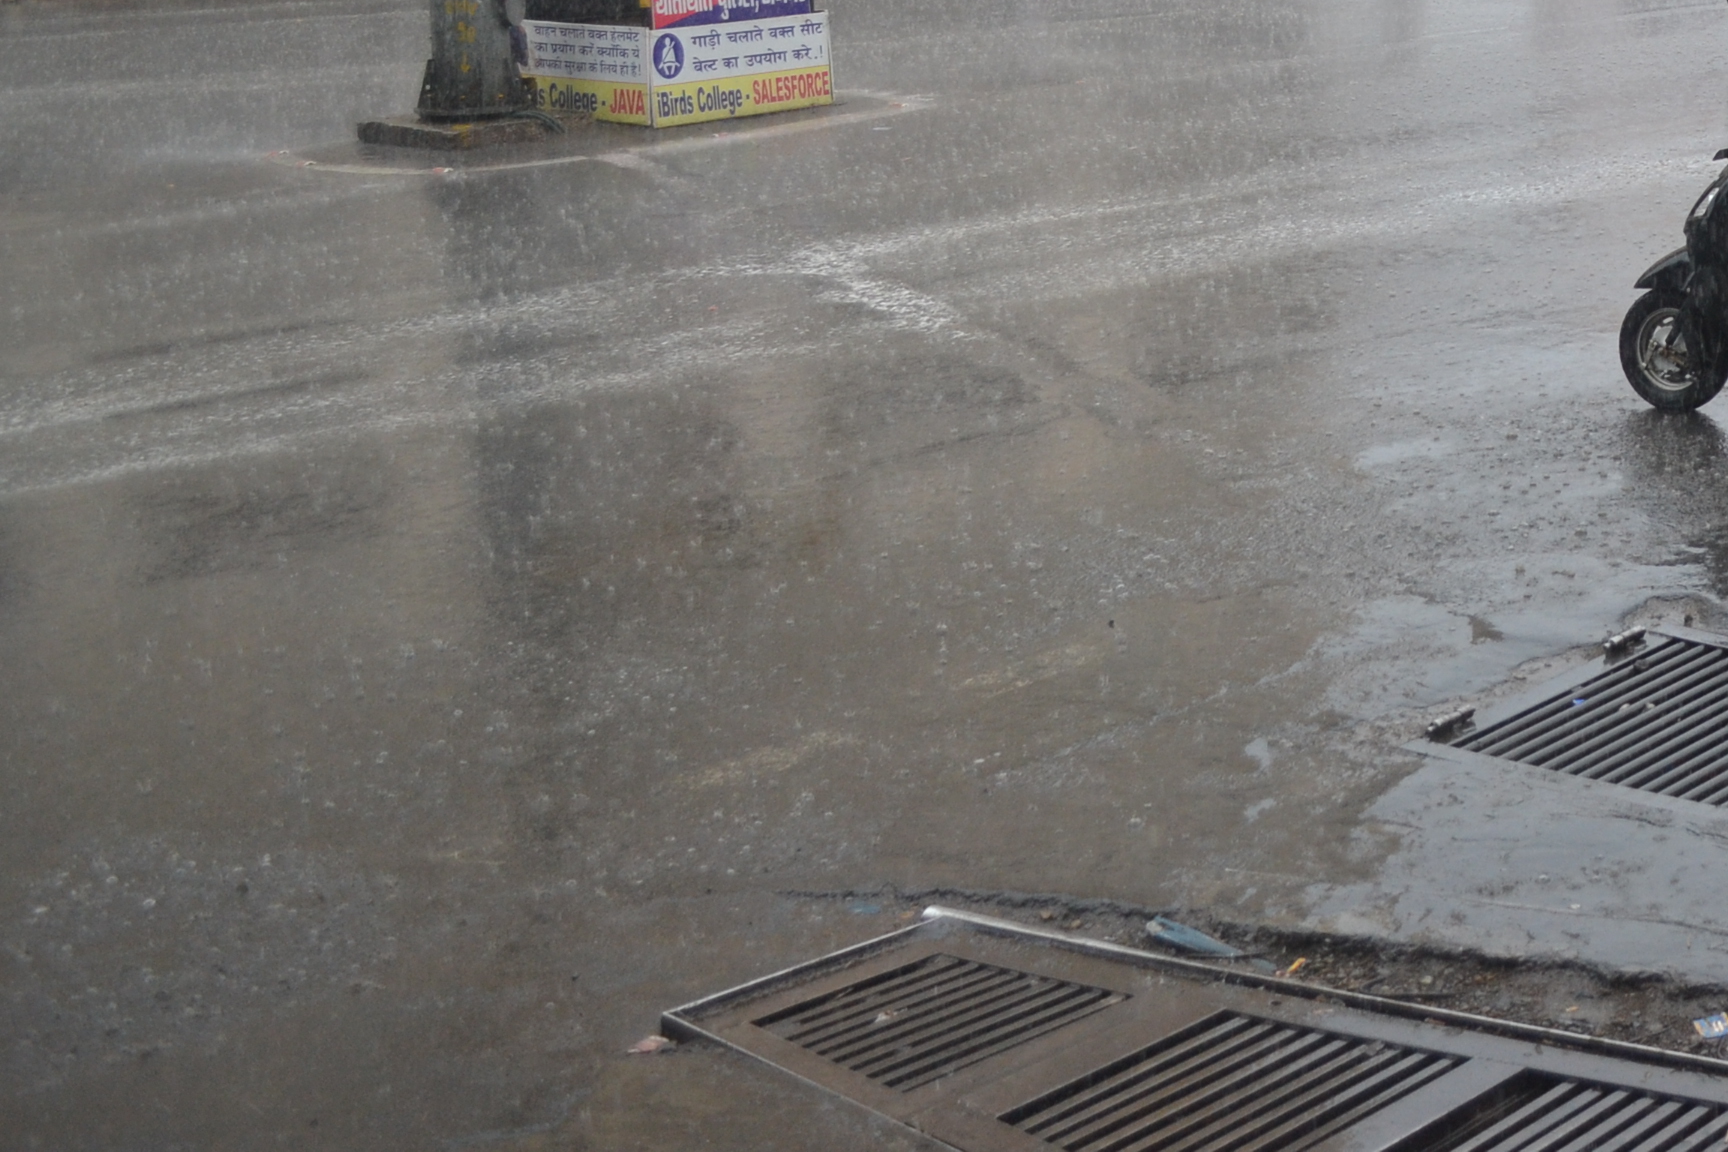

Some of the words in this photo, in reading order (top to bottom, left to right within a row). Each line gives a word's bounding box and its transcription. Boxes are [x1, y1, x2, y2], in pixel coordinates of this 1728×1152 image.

[534, 26, 556, 37] वाहन
[559, 26, 585, 38] चलाते
[588, 30, 608, 41] वक्त
[610, 28, 639, 42] हेलमेट
[691, 29, 721, 49] गाड़ी
[726, 26, 763, 43] चलाते
[768, 26, 795, 39] वक्त
[800, 19, 822, 36] सीट
[535, 42, 548, 52] का
[550, 41, 575, 54] प्रयोग
[579, 43, 594, 57] करें
[597, 46, 629, 58] क्योंकि
[632, 45, 640, 58] ये
[722, 56, 739, 69] का
[744, 49, 788, 66] उपयोग
[565, 61, 585, 75] सुरक्षा
[610, 89, 645, 115] JAVA
[657, 85, 694, 118] iBirds
[697, 87, 743, 115] College
[753, 71, 829, 106] SALESFORCE
